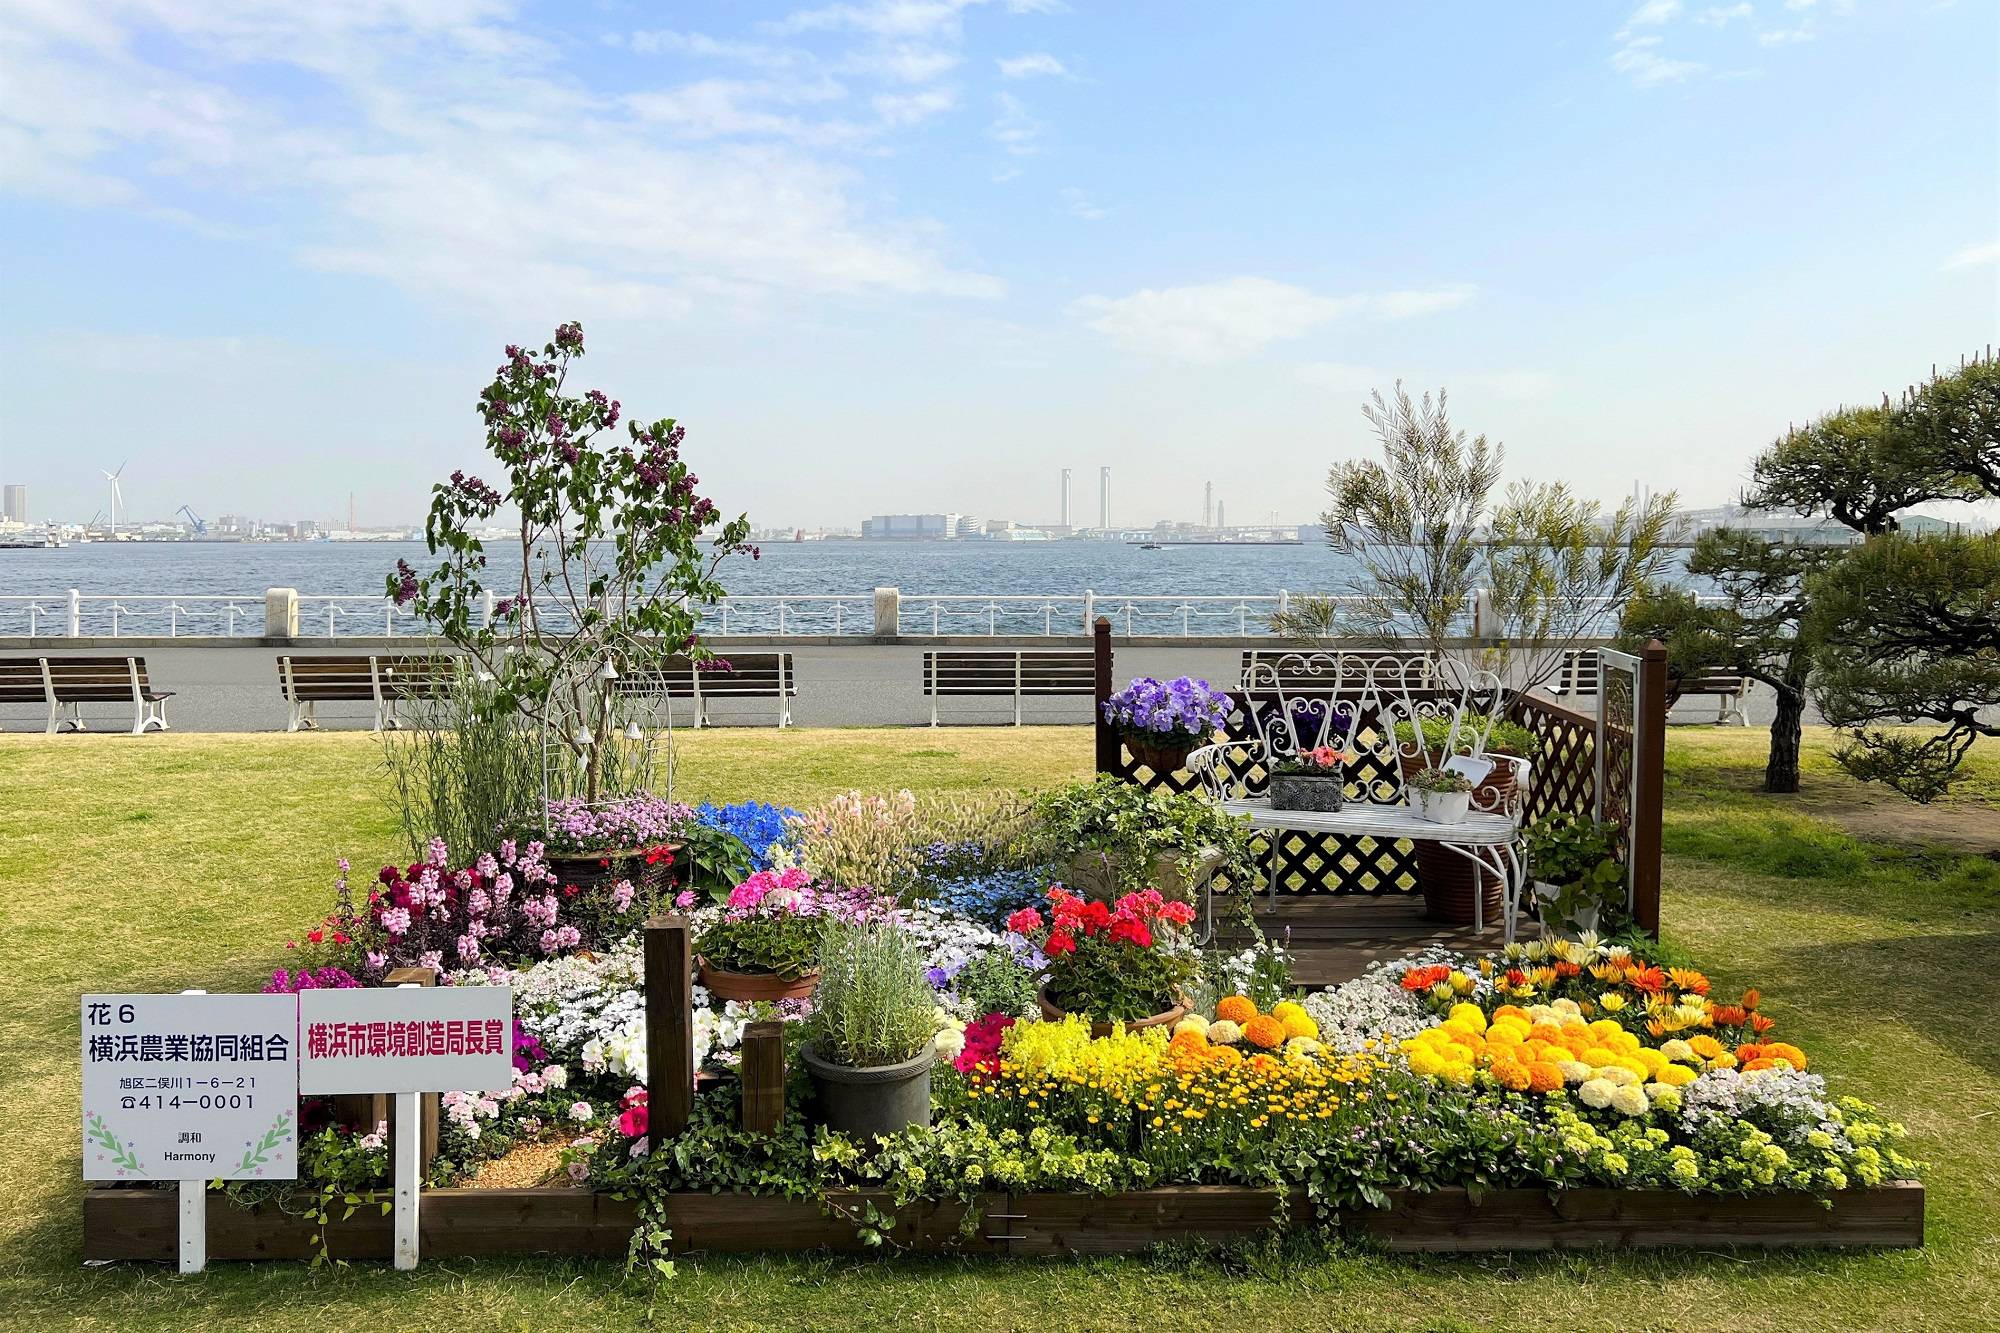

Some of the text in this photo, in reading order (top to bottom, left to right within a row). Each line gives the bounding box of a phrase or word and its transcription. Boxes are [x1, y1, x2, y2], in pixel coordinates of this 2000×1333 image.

[88, 1033, 290, 1063] 横浜農業協同組合
[307, 1018, 504, 1060] 横浜市環境創造局長賞
[177, 1131, 202, 1144] 調和
[164, 1151, 216, 1164] Harmony
